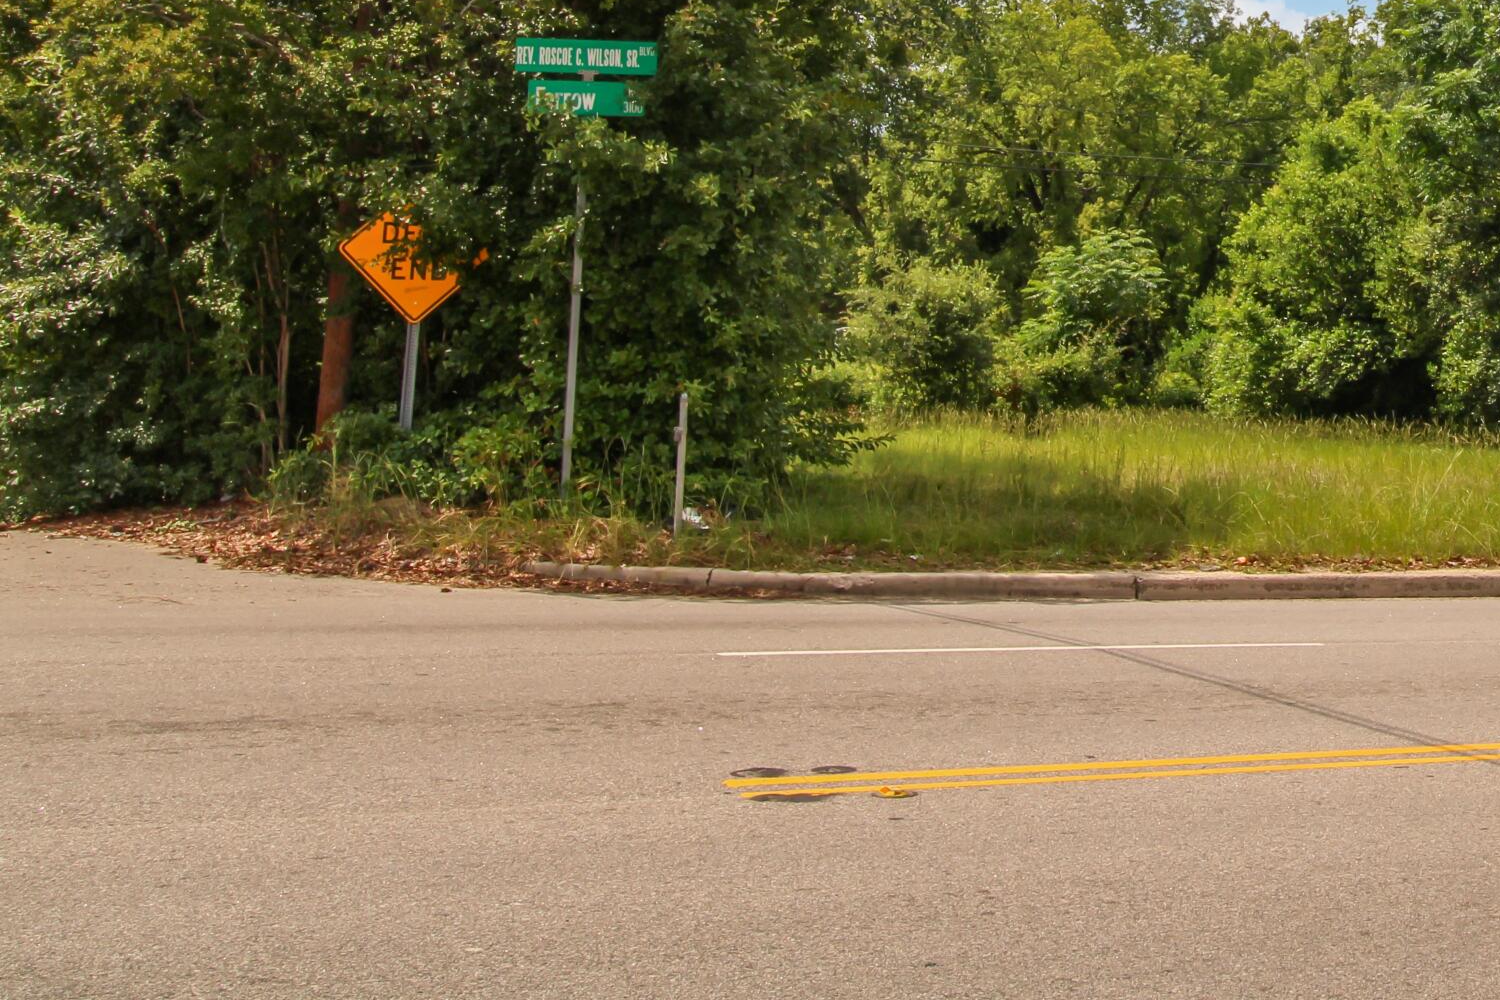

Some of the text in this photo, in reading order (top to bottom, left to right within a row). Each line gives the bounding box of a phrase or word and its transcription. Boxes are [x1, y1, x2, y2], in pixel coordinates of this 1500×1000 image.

[517, 46, 535, 65] REV.
[539, 47, 573, 66] ROSCOE
[587, 48, 623, 68] WILSON,
[626, 50, 640, 68] SR.
[535, 86, 596, 111] Frrow
